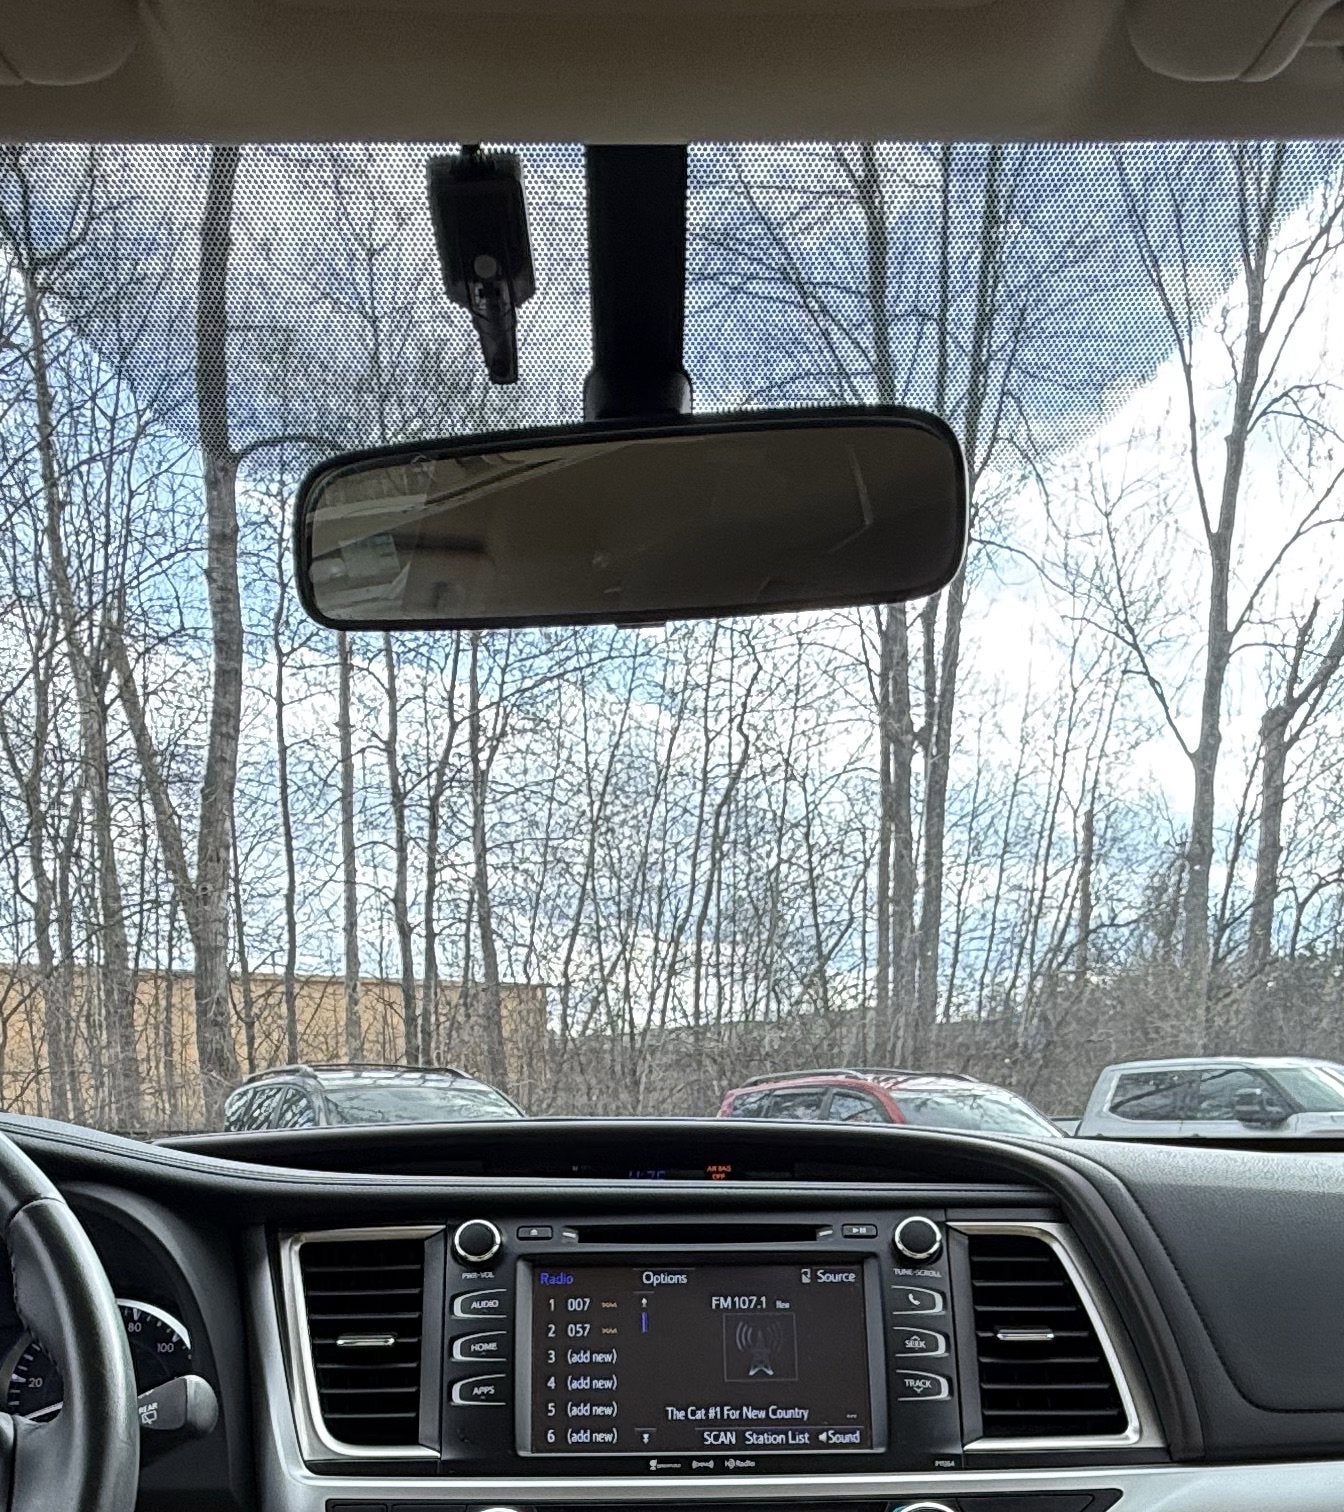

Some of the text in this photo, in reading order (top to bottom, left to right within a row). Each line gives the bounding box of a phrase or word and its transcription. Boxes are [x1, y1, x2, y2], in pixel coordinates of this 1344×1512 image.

[540, 1272, 574, 1285] Radio
[642, 1272, 688, 1286] Options
[816, 1271, 856, 1283] Source
[470, 1300, 499, 1309] AUDIO
[549, 1299, 555, 1311] 1
[567, 1298, 590, 1311] 007
[127, 1322, 142, 1333] 80
[547, 1325, 555, 1337] 2
[567, 1324, 590, 1337] 057
[157, 1342, 174, 1353] 100
[470, 1342, 498, 1352] HOME
[547, 1349, 618, 1365] 3 (add new)
[28, 1377, 43, 1388] 20
[547, 1375, 618, 1390] 4 (add new)
[904, 1379, 931, 1388] TRACK
[472, 1386, 495, 1395] APPS
[138, 1402, 158, 1414] REAR
[547, 1402, 618, 1417] 5 (add new)
[666, 1406, 809, 1421] The Cat #1 For New Country
[547, 1428, 618, 1444] 6 (add new)
[704, 1432, 736, 1444] SCAN
[745, 1431, 810, 1444] Station List
[827, 1431, 860, 1444] Sound
